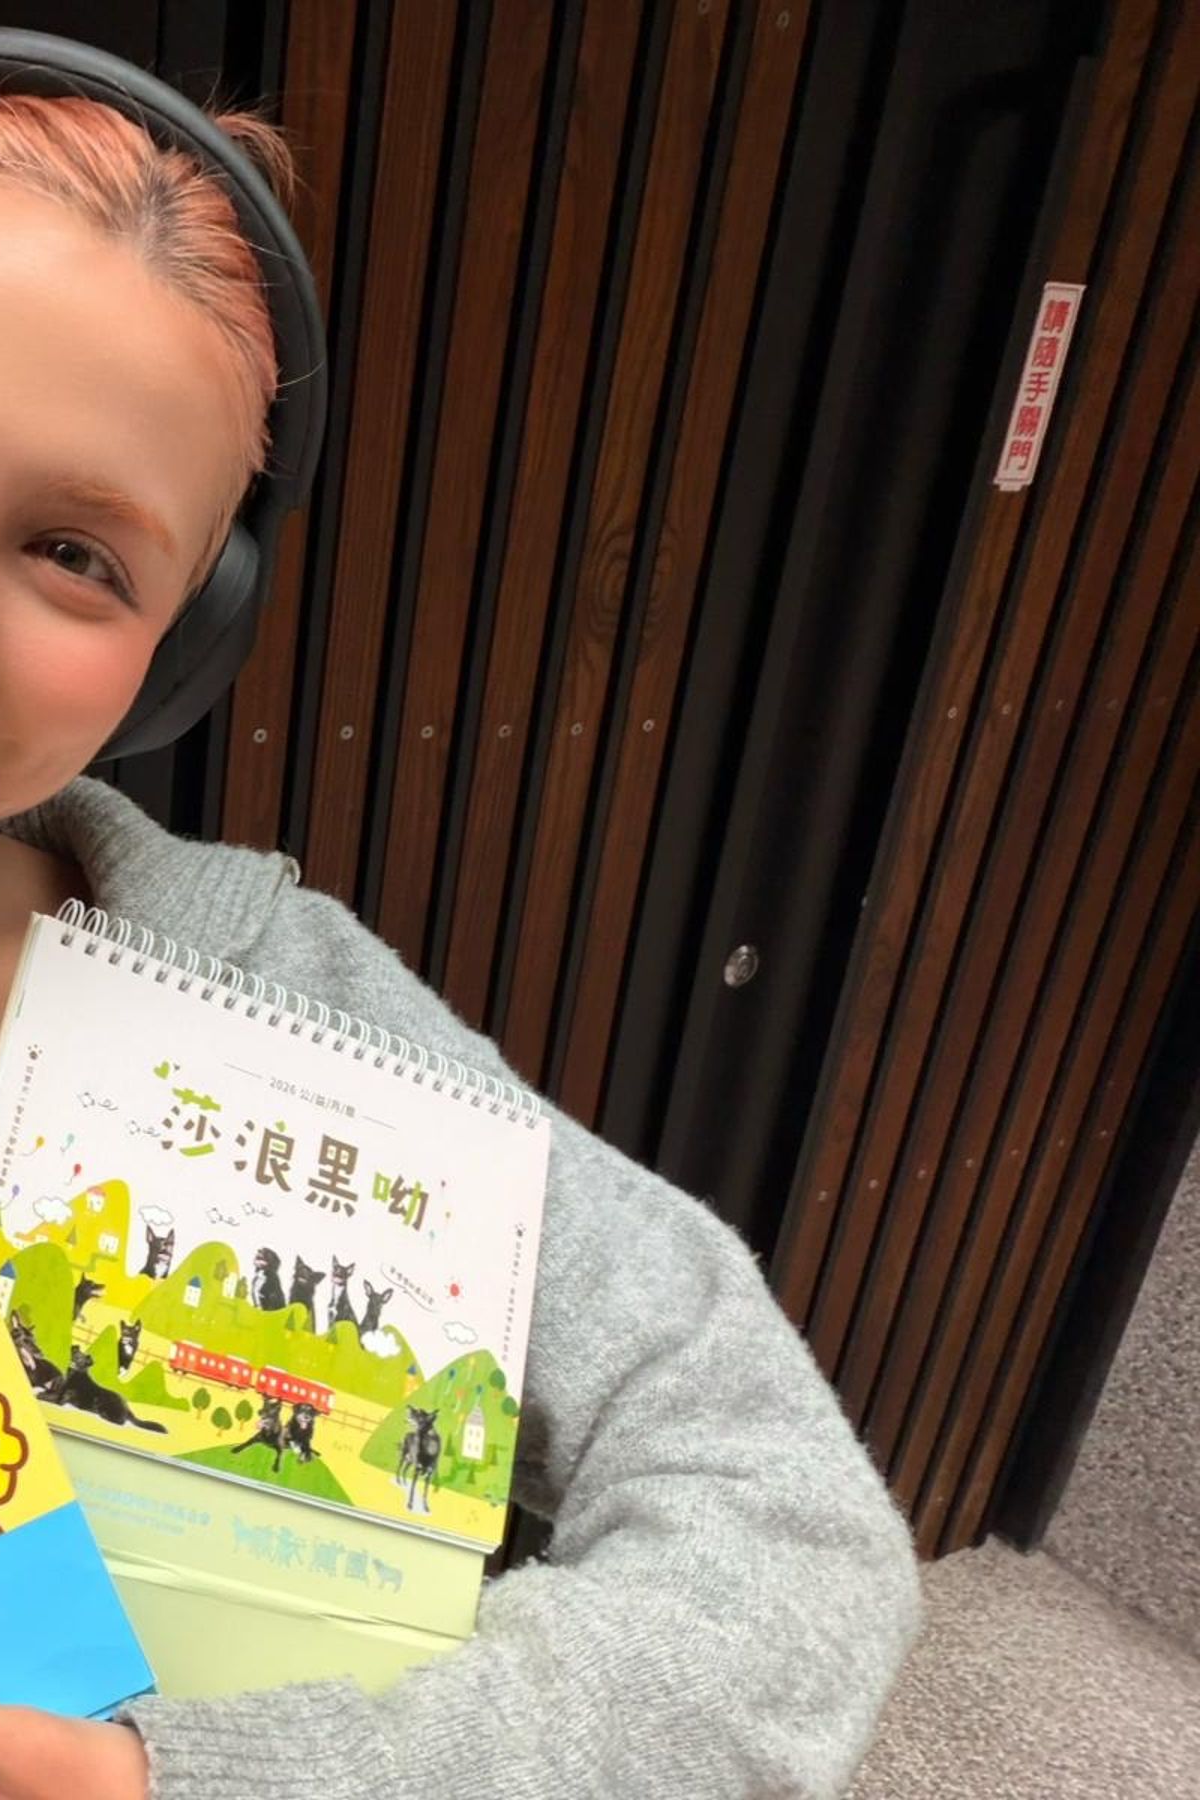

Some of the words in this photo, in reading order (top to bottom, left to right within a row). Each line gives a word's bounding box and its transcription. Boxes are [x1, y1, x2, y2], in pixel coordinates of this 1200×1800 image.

[1004, 299, 1071, 471] 請隨手關門
[160, 1087, 430, 1231] 莎浪黑呦
